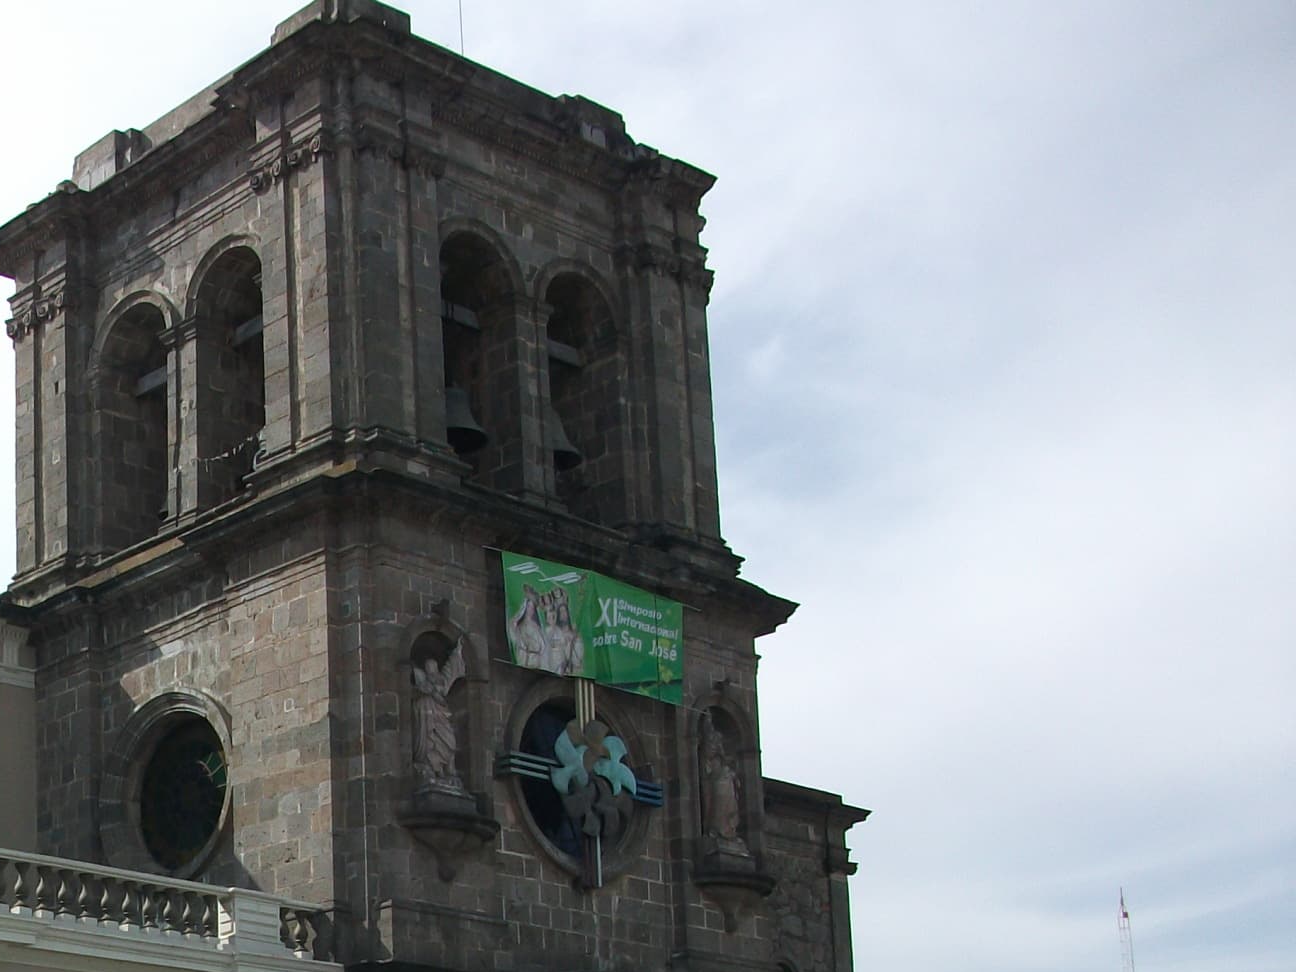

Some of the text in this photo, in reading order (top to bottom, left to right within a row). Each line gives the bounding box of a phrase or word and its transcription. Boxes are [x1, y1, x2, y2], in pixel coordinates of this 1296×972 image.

[594, 597, 662, 628] XI Simposio
[618, 612, 679, 641] Internacional
[592, 630, 677, 661] sobre San José
